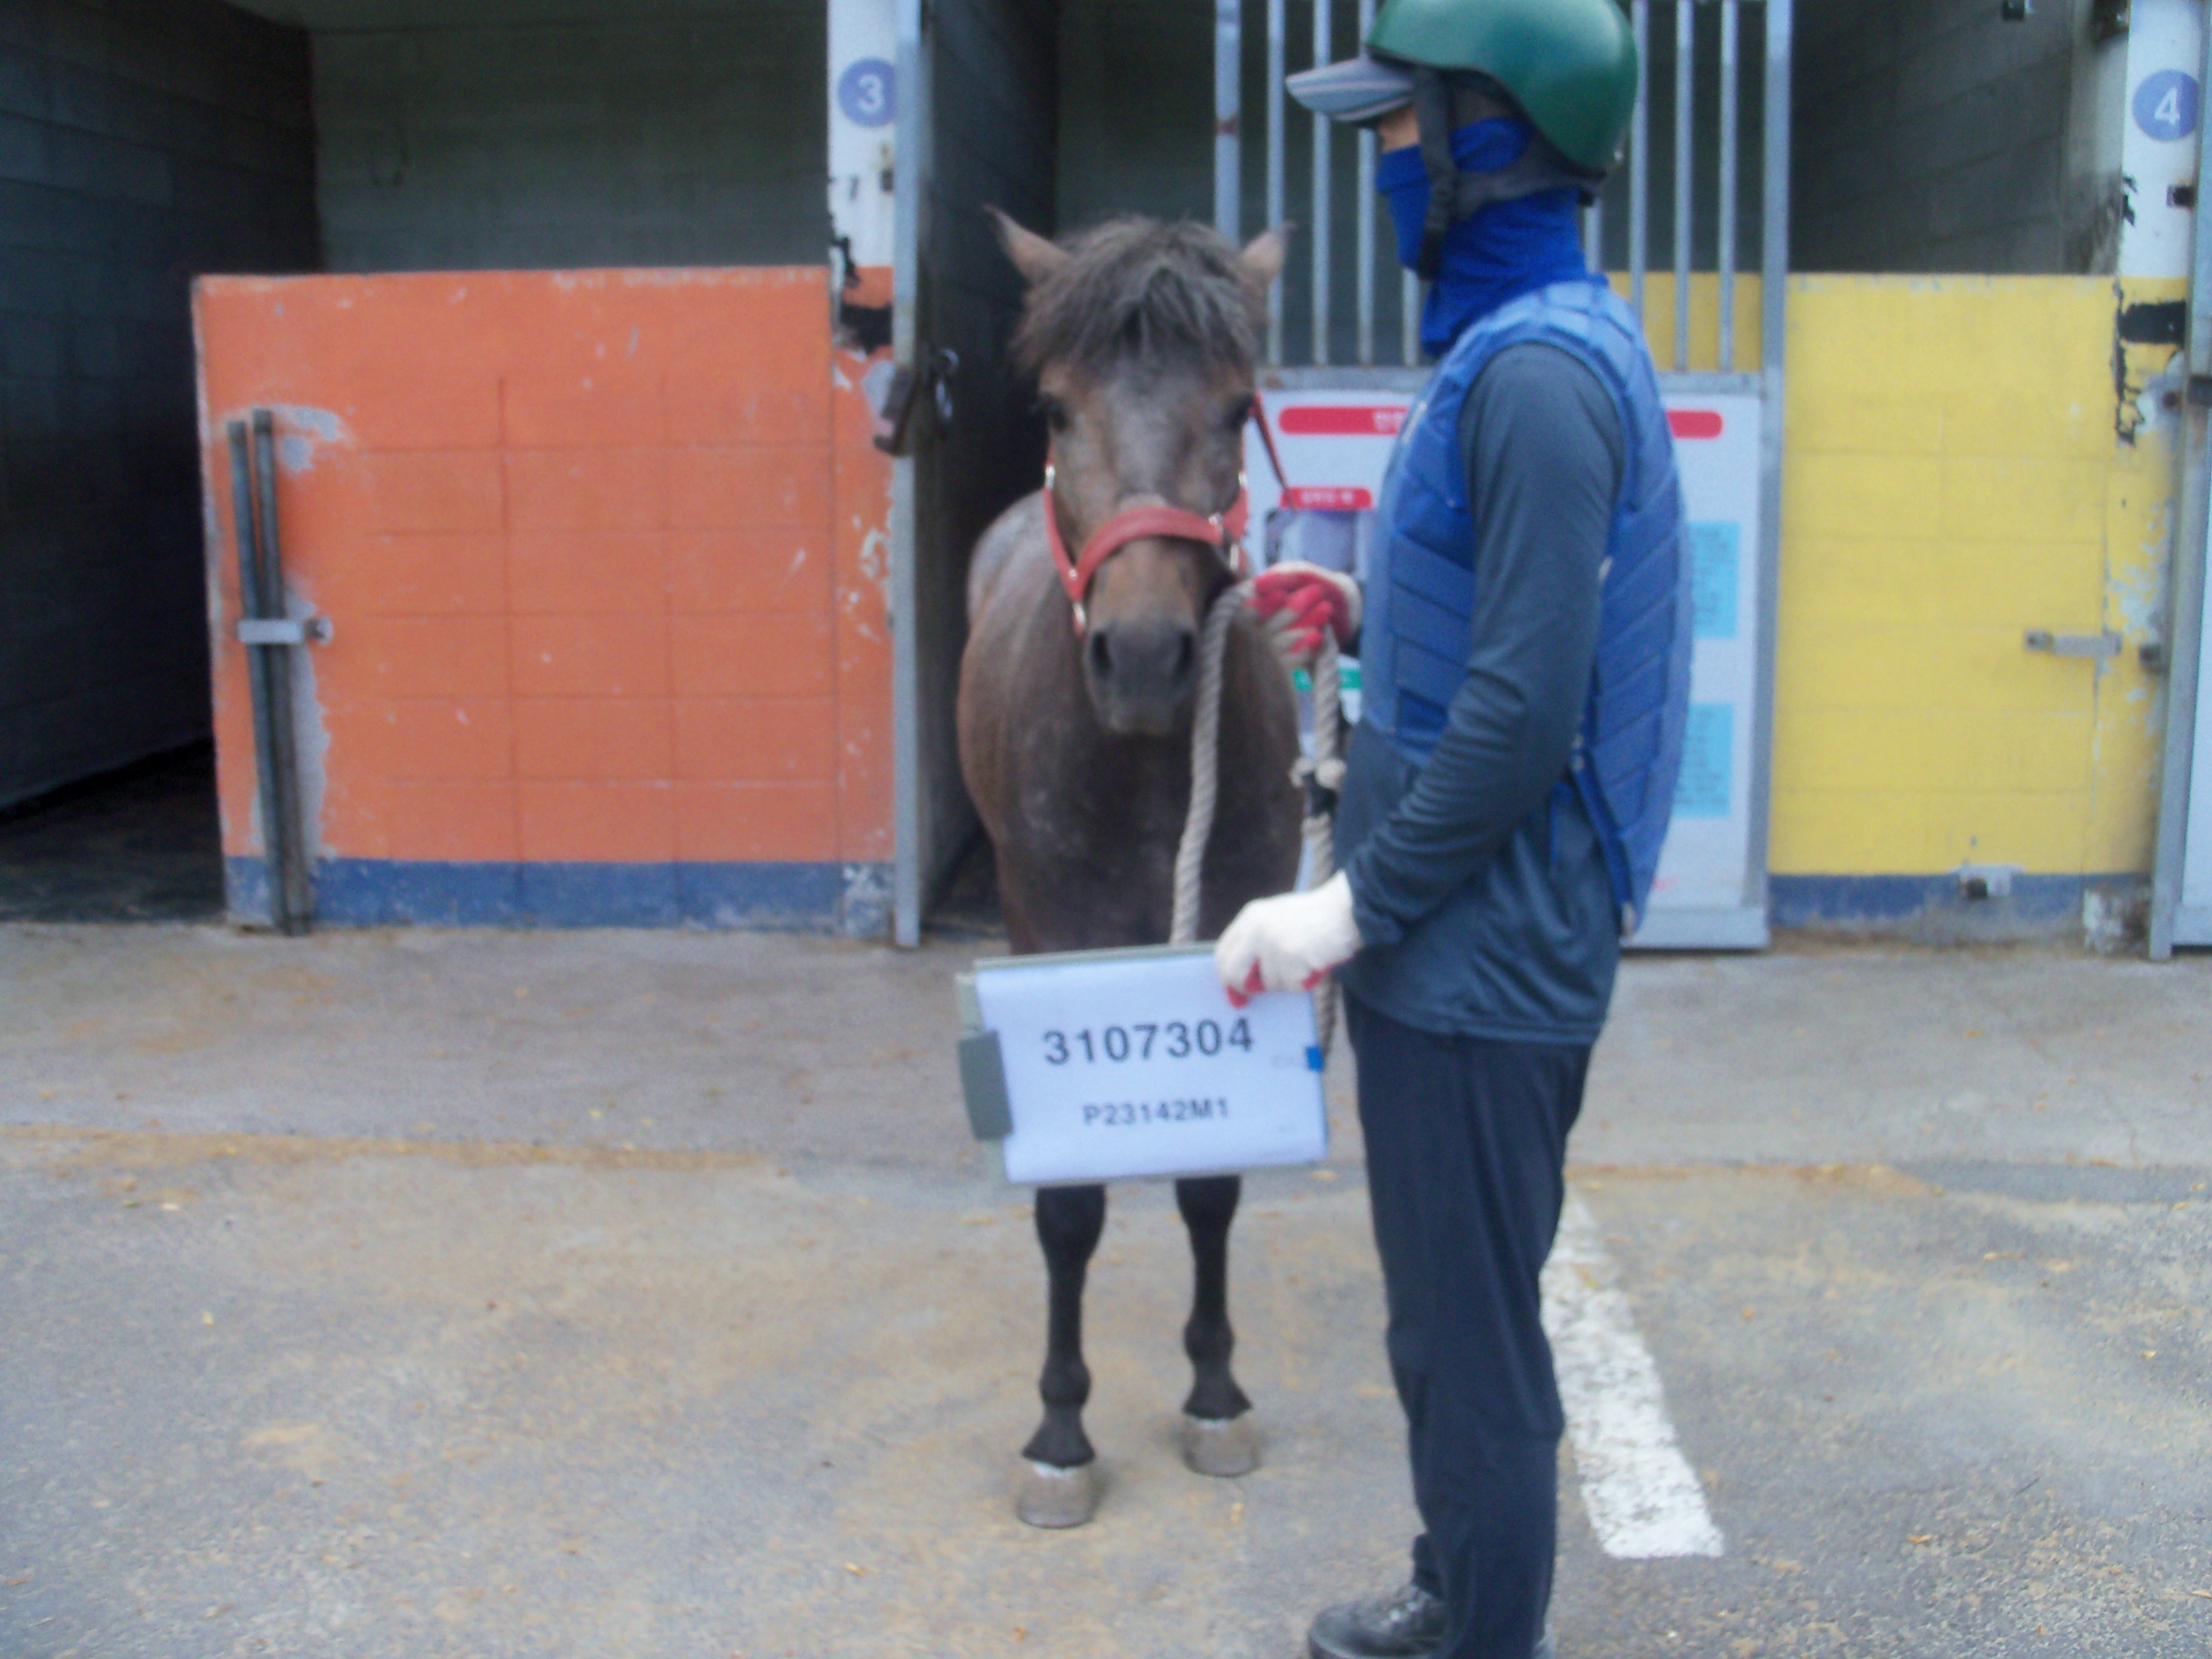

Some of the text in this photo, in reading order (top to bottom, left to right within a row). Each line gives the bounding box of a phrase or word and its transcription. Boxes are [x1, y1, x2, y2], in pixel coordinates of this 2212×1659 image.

[858, 74, 885, 113] 3
[2153, 87, 2180, 125] 4
[1043, 1017, 1253, 1065] 3107304
[1083, 1098, 1228, 1125] P23142M1
